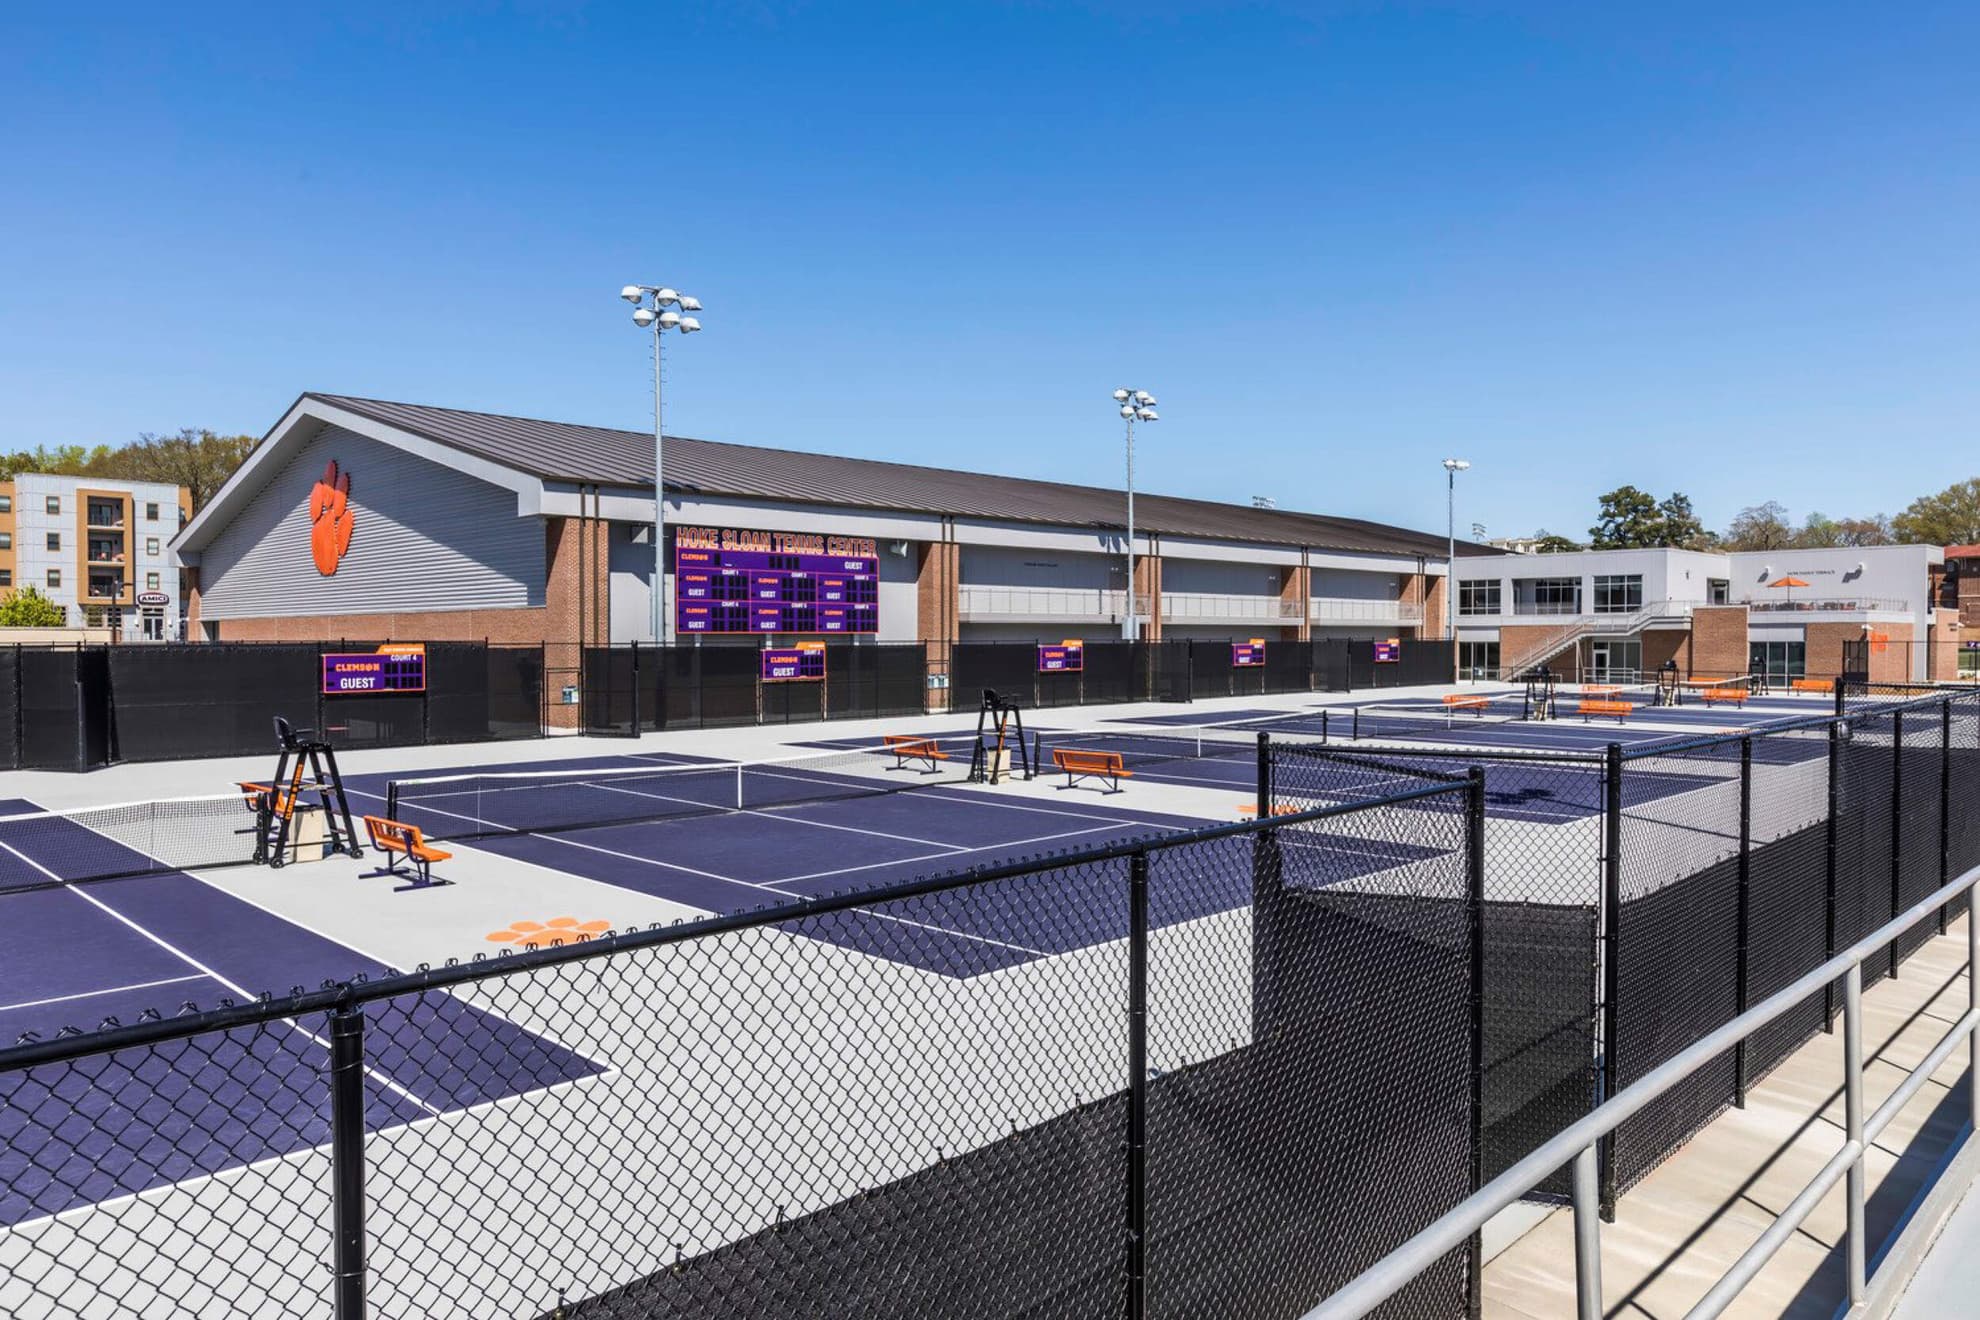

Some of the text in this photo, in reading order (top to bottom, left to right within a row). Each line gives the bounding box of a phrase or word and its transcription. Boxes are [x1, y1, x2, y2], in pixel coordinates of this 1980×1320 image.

[676, 526, 877, 558] HOKE SLOAN TENNIS CENTER
[844, 561, 863, 570] GUEST
[688, 588, 705, 596] GUEST
[760, 590, 776, 598] GUEST
[688, 621, 705, 629] GUEST
[760, 621, 776, 629] GUEST
[390, 654, 412, 662] COURT
[335, 663, 380, 672] CLEMSON
[773, 667, 795, 677] GUEST
[340, 677, 376, 689] GUEST
